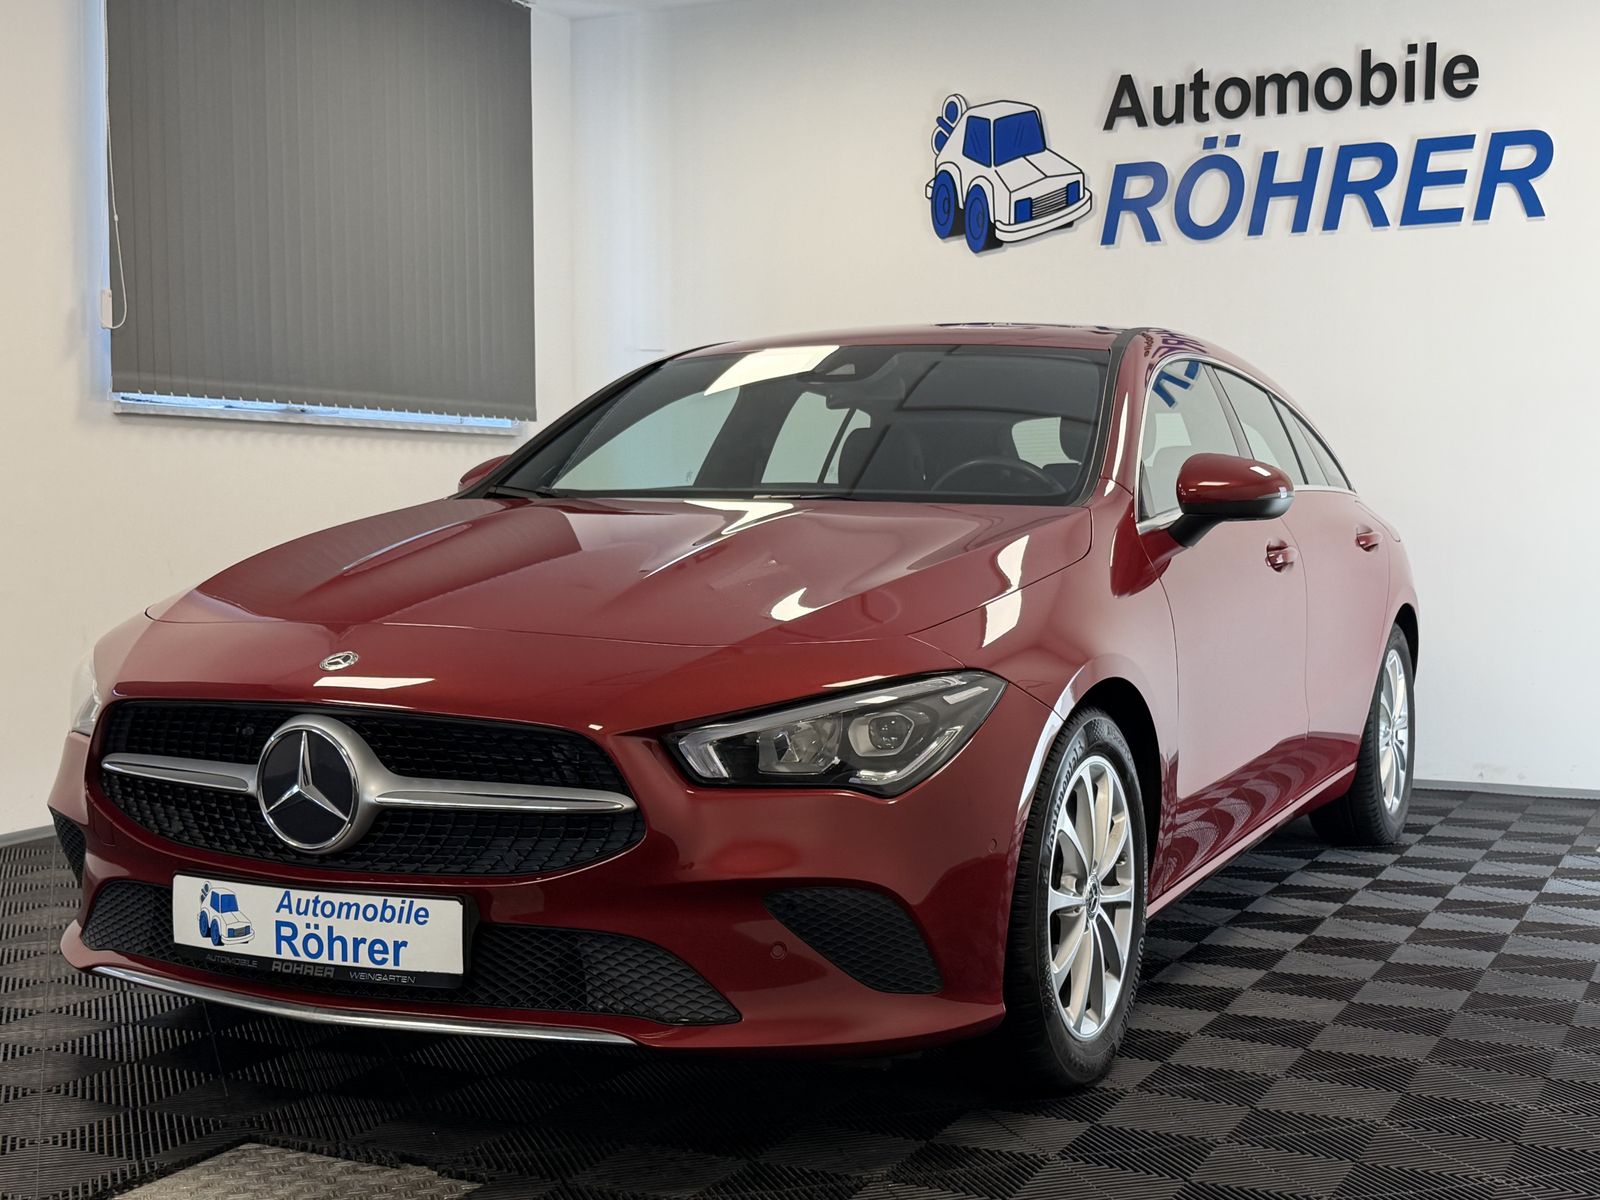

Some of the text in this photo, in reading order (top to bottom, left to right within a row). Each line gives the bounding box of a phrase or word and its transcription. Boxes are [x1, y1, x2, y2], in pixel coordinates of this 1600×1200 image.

[1104, 42, 1480, 131] Automobile
[1101, 129, 1554, 246] RÖHRER
[275, 891, 430, 926] Automobile
[275, 920, 409, 968] Röhrer
[205, 954, 258, 968] AUTOMOBILE
[349, 971, 417, 984] WEINGARTEN
